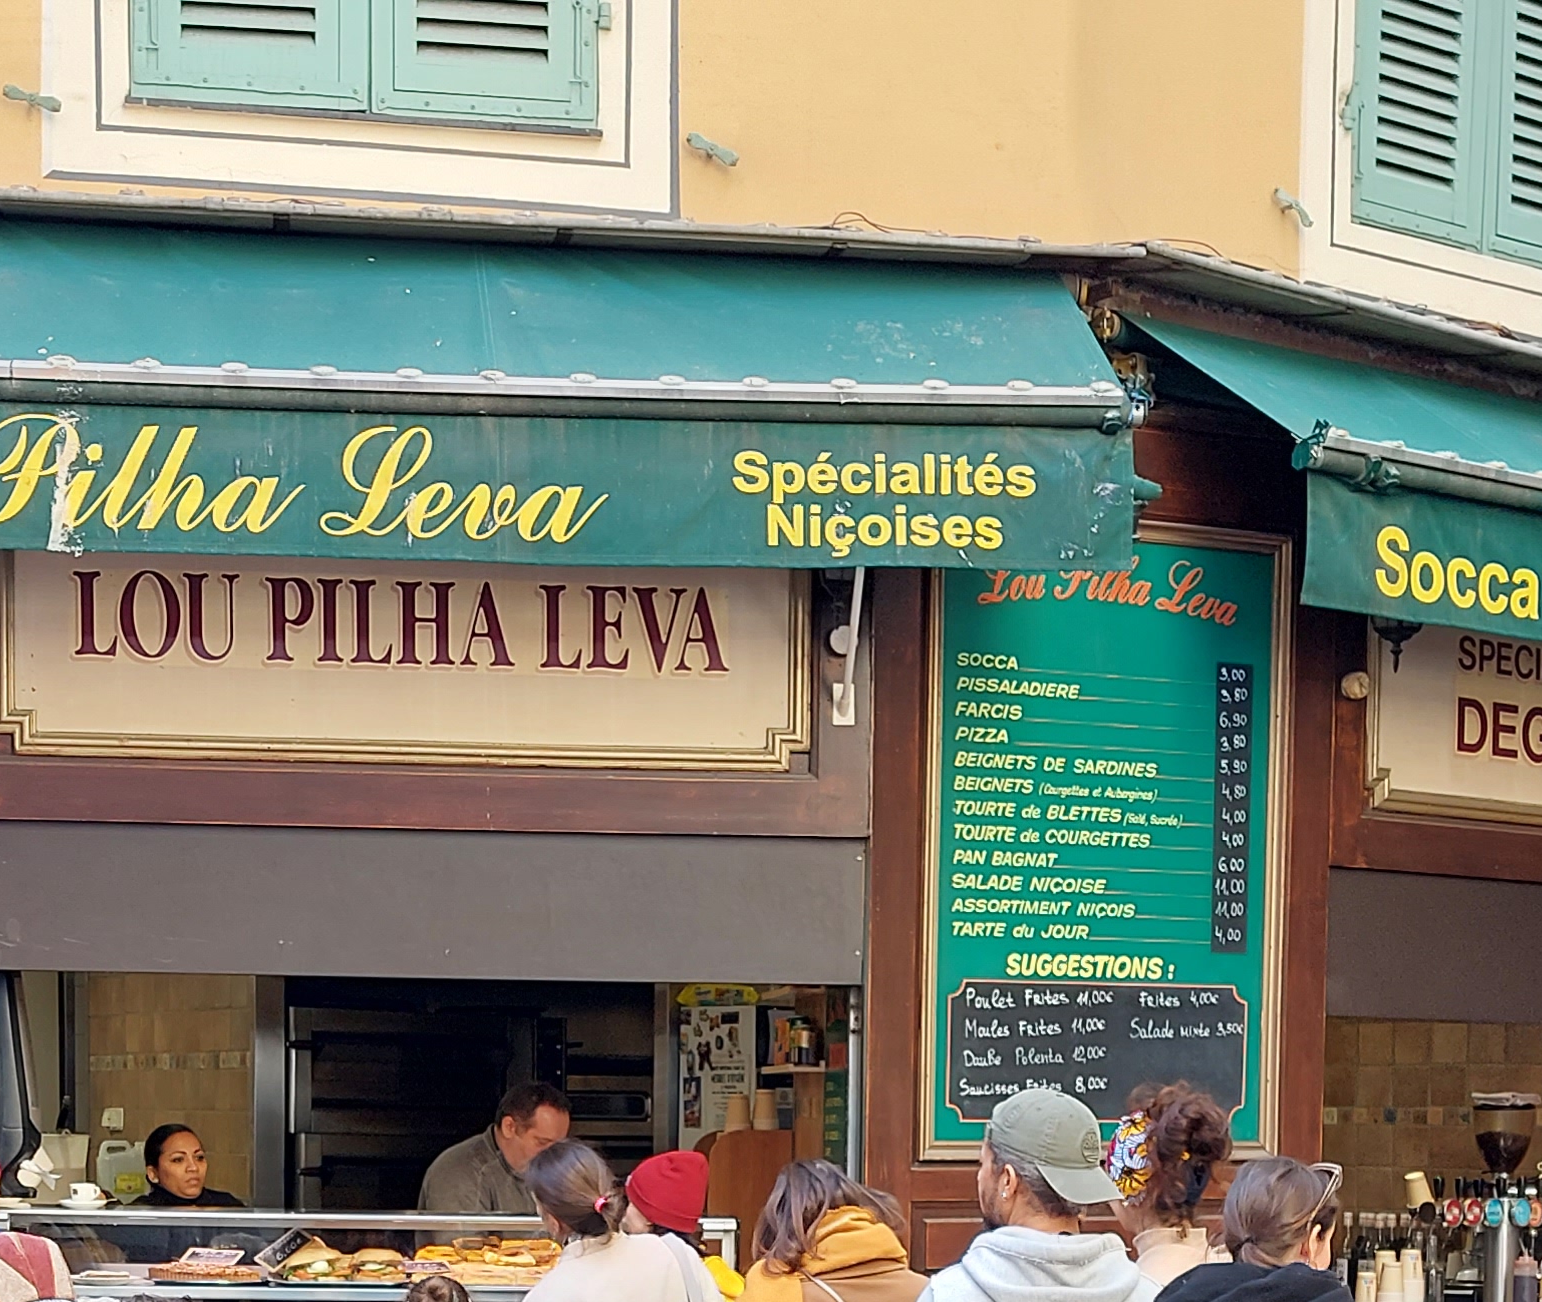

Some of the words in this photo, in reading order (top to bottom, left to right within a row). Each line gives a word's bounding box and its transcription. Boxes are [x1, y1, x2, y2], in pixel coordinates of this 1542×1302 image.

[321, 423, 608, 543] Leva
[731, 447, 1038, 500] Spécialités
[764, 500, 1005, 556] Niçoises
[1373, 525, 1540, 622] Socca
[1154, 560, 1238, 626] Leva
[69, 568, 240, 665] LOU
[264, 575, 512, 669] PILHA
[540, 583, 732, 675] LEVA
[956, 652, 1019, 670] SOCCA
[1219, 667, 1246, 682] 3,00
[956, 676, 1080, 699] PISSALADIERE
[1220, 687, 1248, 704] 3,80
[955, 701, 1023, 720] FARCIS
[955, 726, 1009, 744] PIZZA
[1220, 734, 1247, 752] 3,80
[954, 751, 1038, 770] BEIGNETS
[1043, 756, 1066, 772] DE
[1073, 758, 1158, 778] SARDINES
[954, 775, 1034, 794] BEIGNETS
[1221, 783, 1247, 801] 4,80
[954, 800, 1017, 817] TOURTE
[1021, 804, 1041, 819] de
[1046, 804, 1122, 823] BLETTES
[1222, 807, 1246, 826] 4,00
[954, 824, 1017, 842] TOURTE
[1020, 828, 1040, 843] de
[1044, 829, 1151, 848] COURGETTES
[1222, 831, 1244, 849] 4,00
[953, 849, 987, 865] PAN
[991, 850, 1058, 868] BAGNAT
[951, 873, 1023, 891] SALADE
[1029, 877, 1107, 895] NIÇOISE
[951, 898, 1072, 915] ASSORTIMENT
[1076, 902, 1136, 919] NIÇOIS
[951, 921, 1007, 937] TARTE
[1012, 923, 1035, 939] du
[1040, 924, 1090, 940] JOUR
[1214, 925, 1241, 945] 4,00
[966, 987, 1016, 1009] Poulet
[964, 1018, 1010, 1039] Moules
[1129, 1017, 1174, 1039] Salade
[963, 1048, 1002, 1068] Daube
[1015, 1047, 1064, 1066] Polenta
[959, 1078, 1020, 1096] Saucisses
